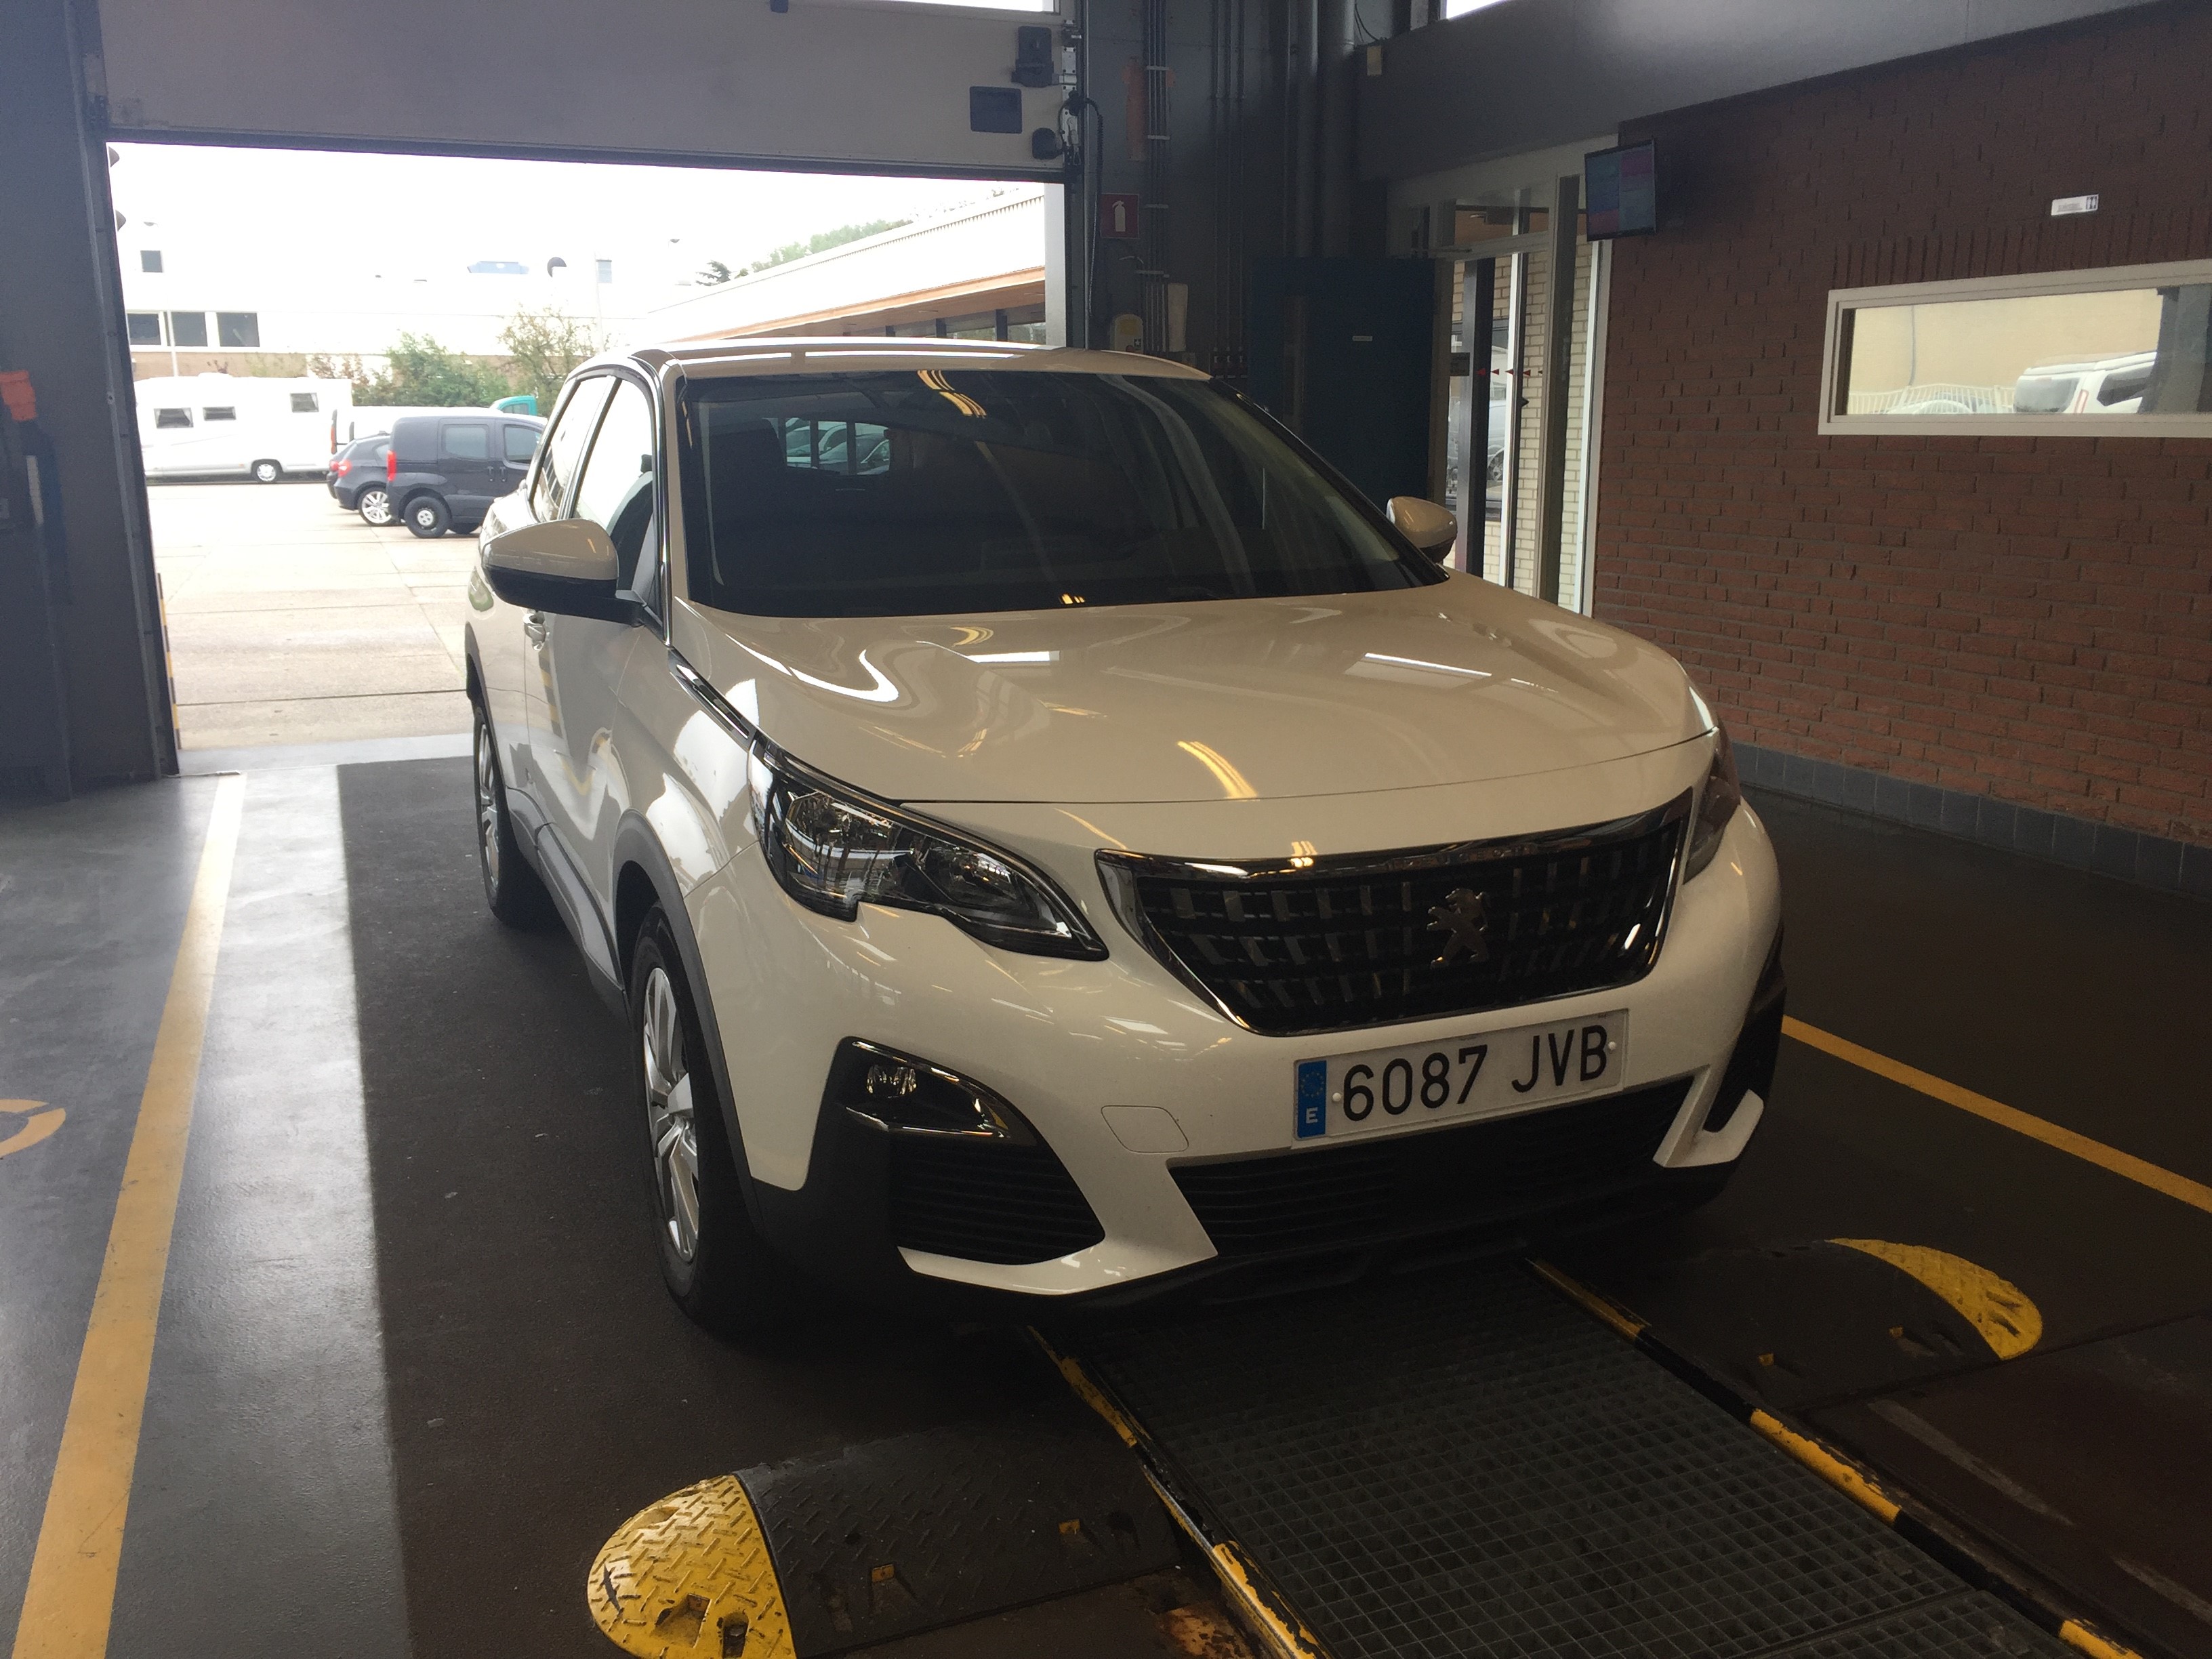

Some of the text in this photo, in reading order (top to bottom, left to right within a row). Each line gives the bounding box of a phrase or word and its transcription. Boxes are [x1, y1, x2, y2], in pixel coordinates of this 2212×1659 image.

[1343, 1025, 1607, 1121] 6087 JVB
[1305, 1107, 1319, 1124] E
